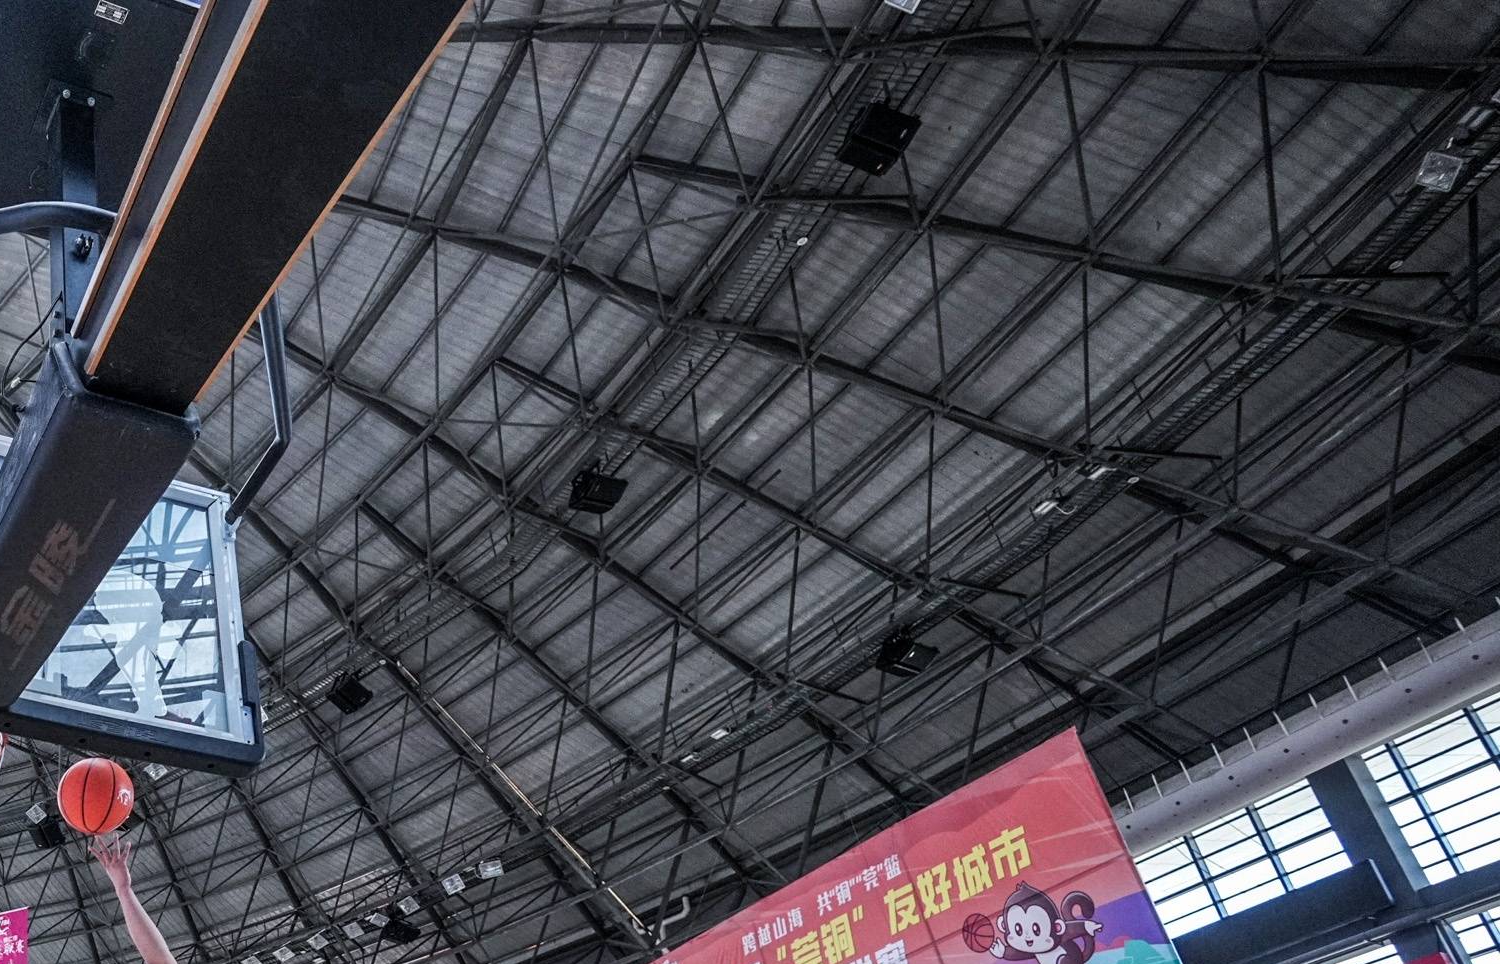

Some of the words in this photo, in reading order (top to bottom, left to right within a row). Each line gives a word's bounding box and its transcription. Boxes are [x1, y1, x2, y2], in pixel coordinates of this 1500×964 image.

[884, 825, 1032, 935] 友好城市
[742, 907, 803, 956] 跨越山海
